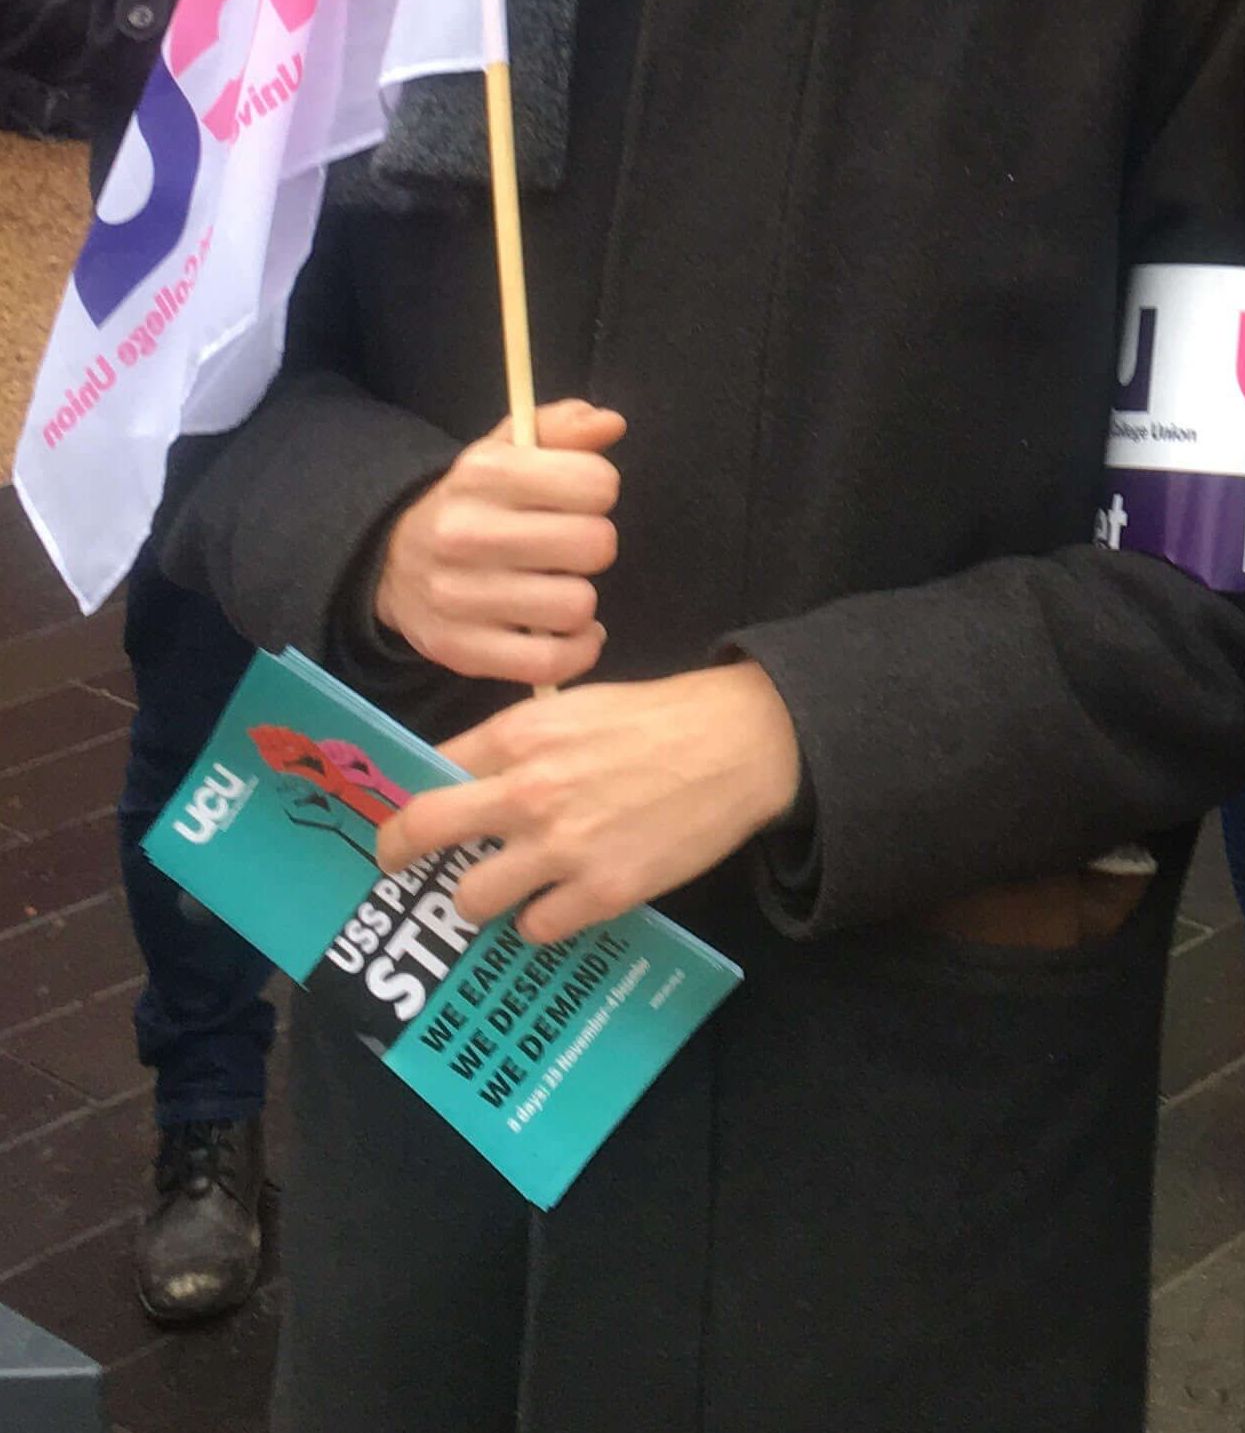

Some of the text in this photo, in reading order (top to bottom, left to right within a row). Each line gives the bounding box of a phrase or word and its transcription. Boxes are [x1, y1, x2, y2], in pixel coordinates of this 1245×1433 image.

[172, 761, 248, 845] UCU
[325, 901, 393, 974] USS
[420, 1001, 468, 1054] WE
[447, 1029, 498, 1082] WE
[479, 1056, 529, 1110] WE
[517, 954, 611, 1063] DEMAND
